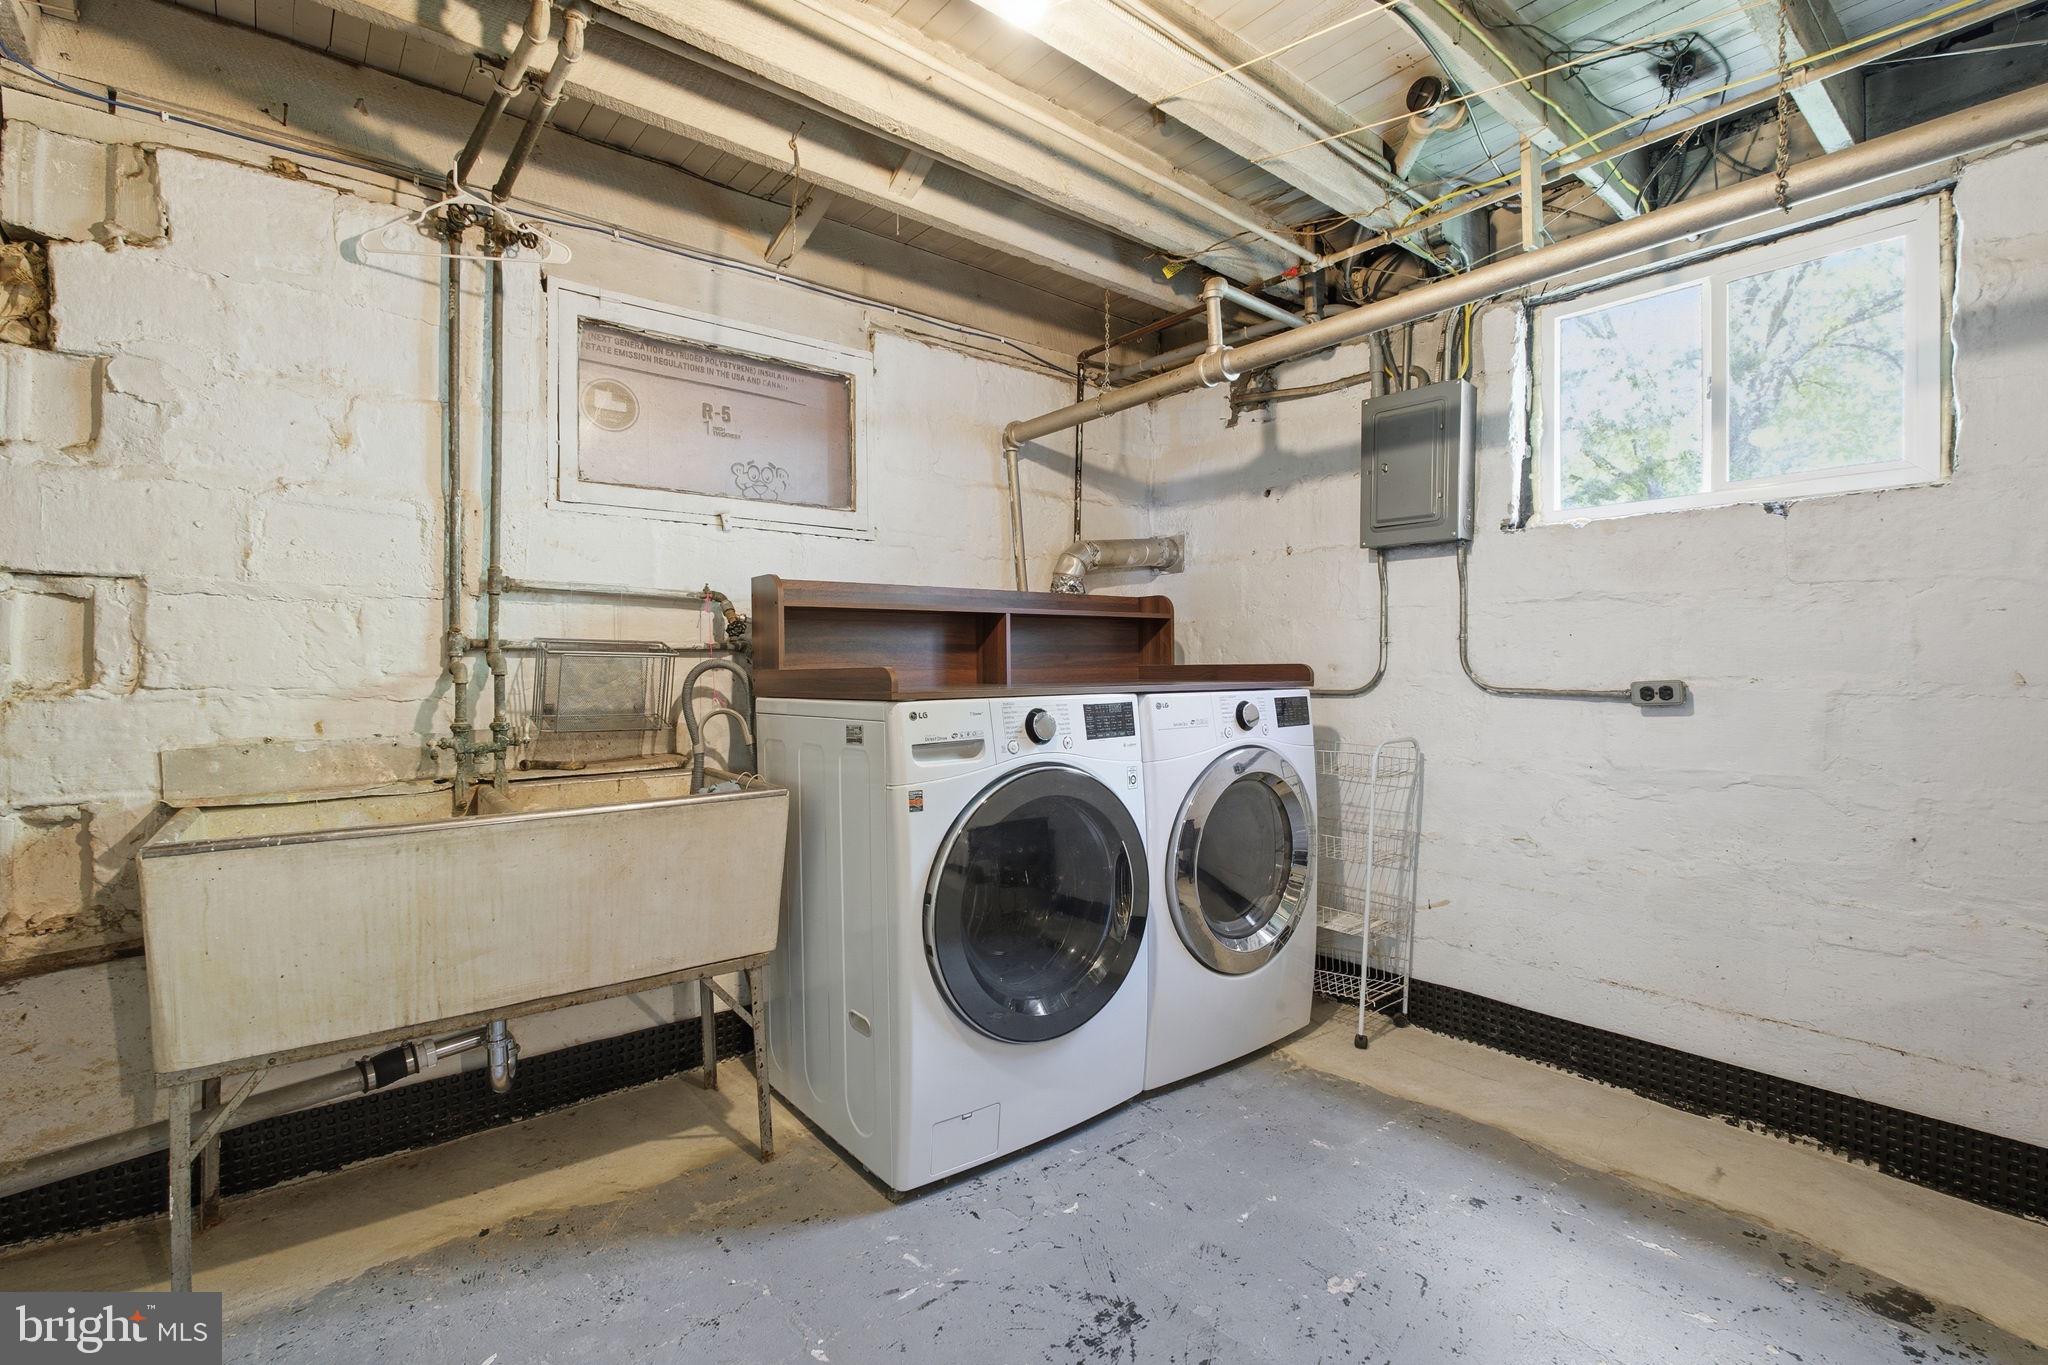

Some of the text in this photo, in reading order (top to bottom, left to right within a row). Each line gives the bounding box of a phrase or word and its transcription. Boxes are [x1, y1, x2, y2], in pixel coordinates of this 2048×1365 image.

[585, 342, 613, 355] STATE
[614, 348, 652, 363] EMISSION
[654, 356, 705, 374] REGULATIONS
[707, 367, 714, 376] IN
[716, 369, 729, 379] THE
[731, 373, 745, 382] USA
[747, 377, 760, 386] AND
[762, 379, 788, 390] CANA
[614, 337, 664, 355] GENERATION
[665, 349, 703, 362] EXTRUDED
[703, 355, 756, 376] POLYSTYRENE)
[702, 402, 731, 422] R-5
